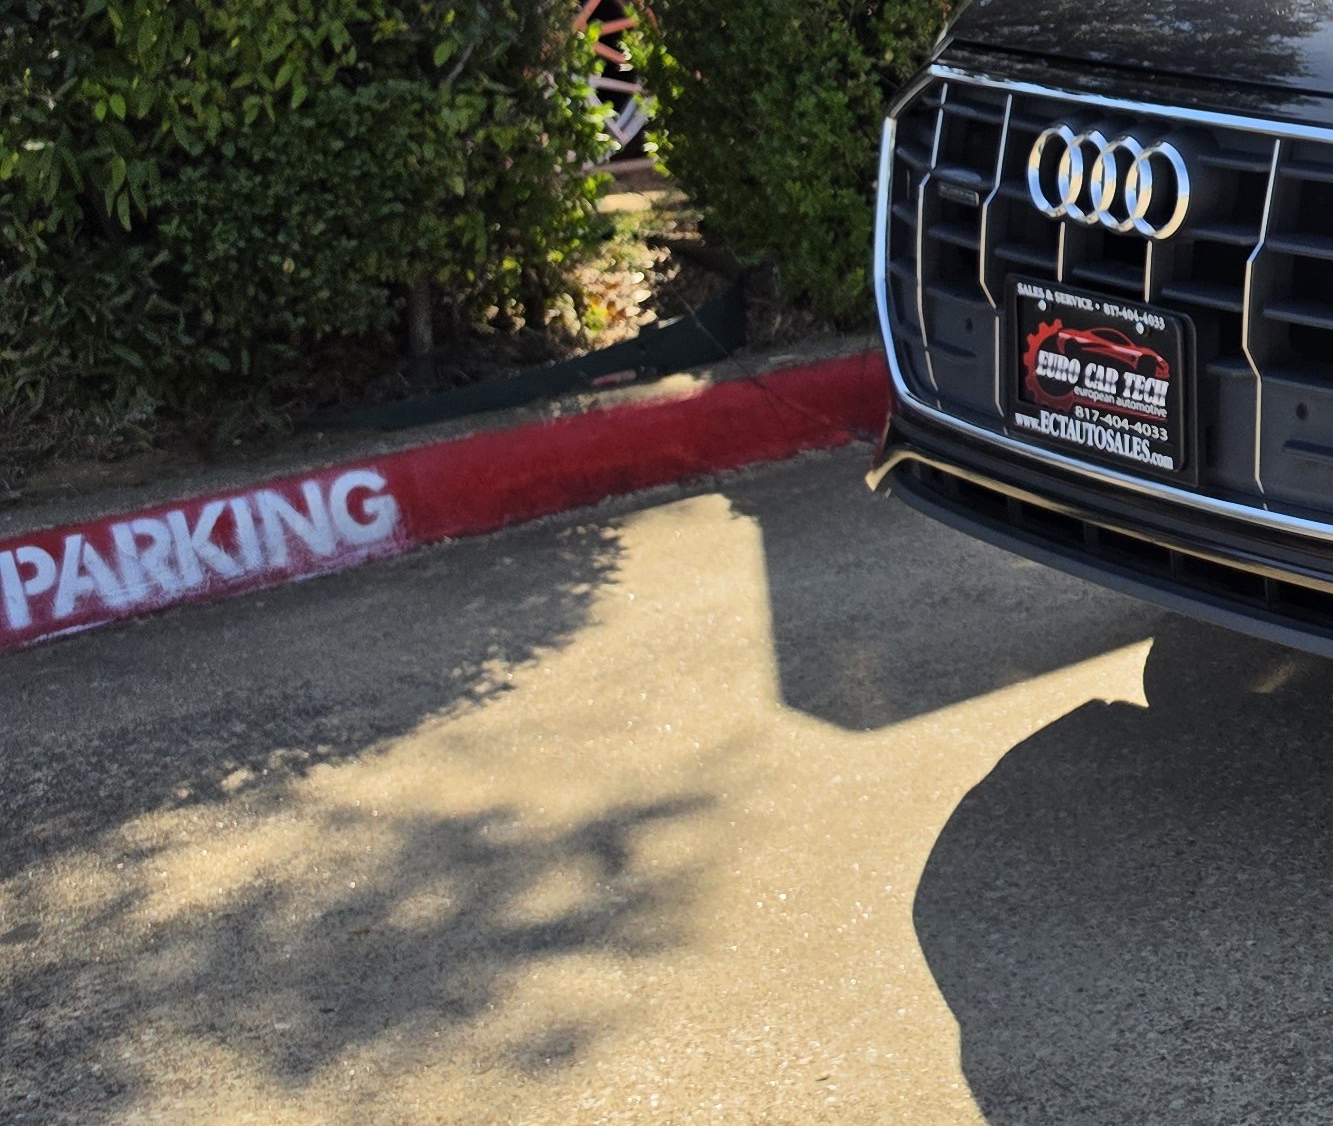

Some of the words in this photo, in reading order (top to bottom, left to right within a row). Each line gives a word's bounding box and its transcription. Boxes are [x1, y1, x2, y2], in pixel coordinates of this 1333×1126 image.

[1017, 282, 1045, 299] SALES
[1054, 291, 1094, 311] SERVICE
[1103, 303, 1166, 331] 817-404-4033
[1036, 350, 1081, 385] EURO
[1084, 362, 1120, 395] CAR
[1123, 371, 1170, 407] TECH
[1073, 385, 1116, 404] european
[1116, 396, 1168, 418] automotive
[1015, 409, 1174, 470] www.ECTAUTOSALES.com
[1075, 405, 1169, 442] 817-404-4033
[0, 467, 400, 630] PARKING
